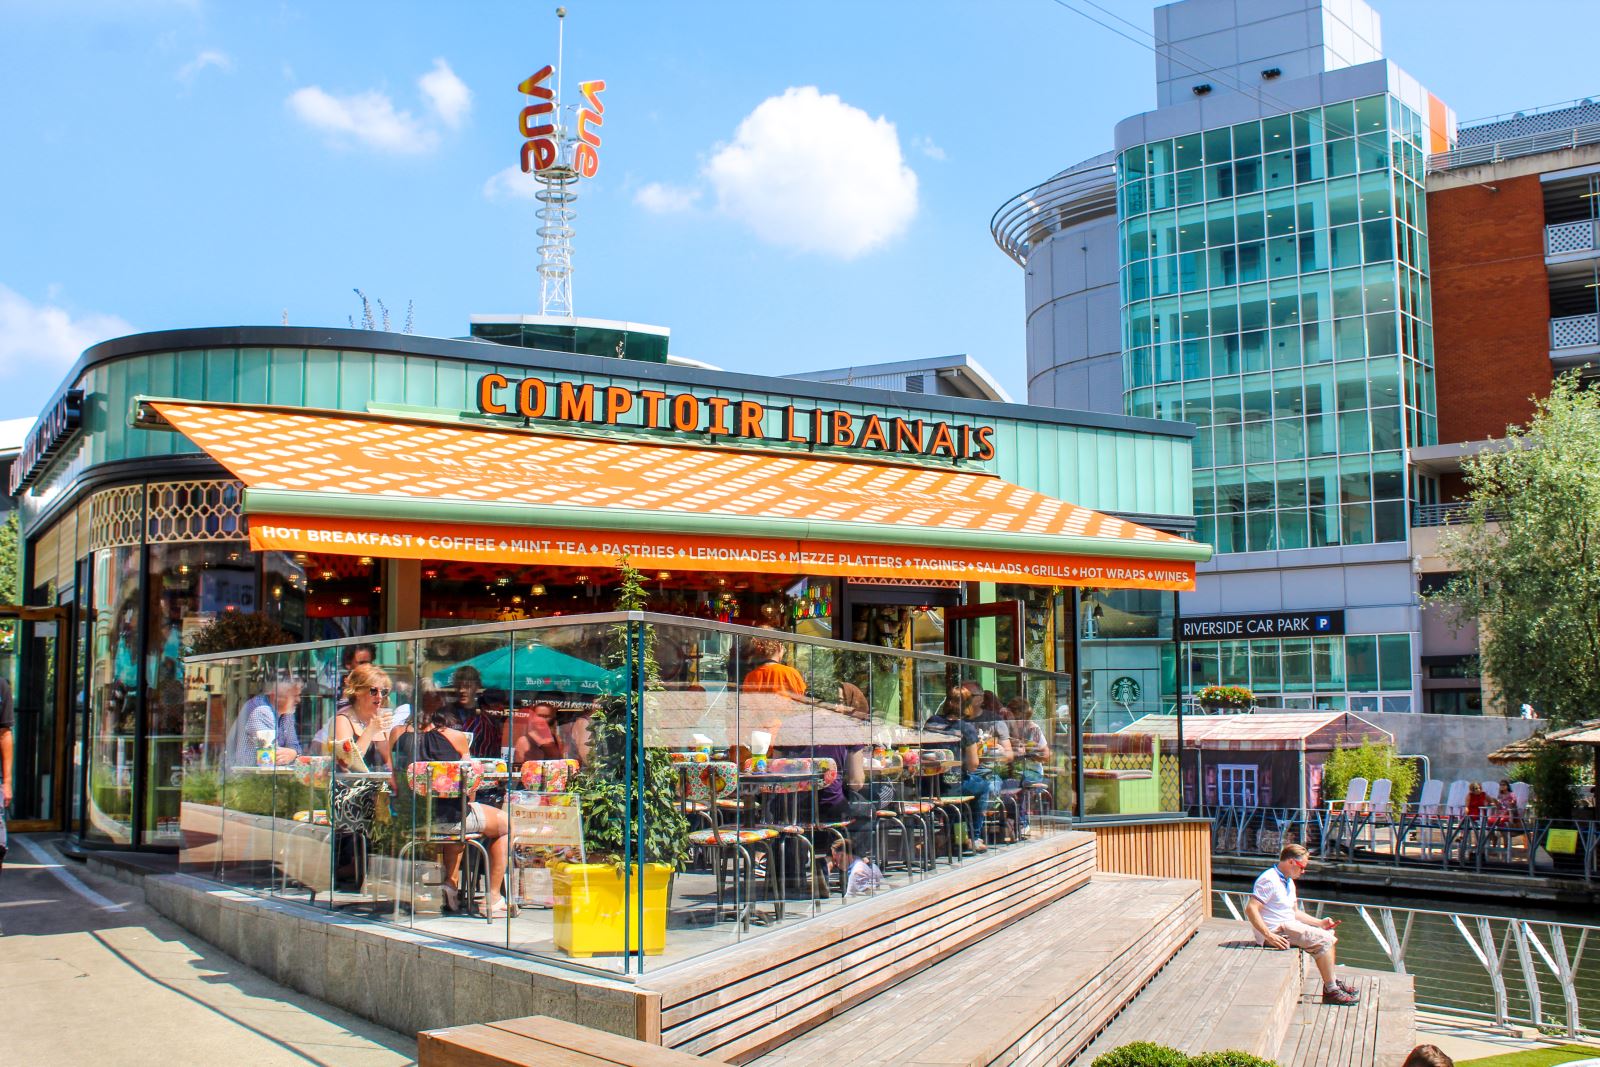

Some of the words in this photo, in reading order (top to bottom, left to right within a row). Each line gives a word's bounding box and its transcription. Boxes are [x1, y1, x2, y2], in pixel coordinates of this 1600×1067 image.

[518, 65, 558, 174] vue
[573, 80, 606, 178] vue
[479, 373, 764, 438] COMPTOIR
[784, 404, 995, 461] LIBANAIS
[361, 450, 604, 475] COMPTOIR
[262, 525, 302, 540] HOT
[306, 528, 414, 548] BREAKFAST
[428, 535, 496, 552] COFFEE
[510, 539, 551, 554] MINT
[555, 540, 588, 556] TEA
[601, 543, 676, 559] PASTRIES
[688, 547, 778, 563] LEMONADES
[788, 551, 835, 566] MEZZE
[838, 553, 903, 569] PLATTERS
[912, 557, 966, 572] TAGINES
[975, 561, 1022, 575] SALADS
[1031, 564, 1071, 577] GRILLS
[1079, 567, 1103, 579] HOT
[1105, 568, 1146, 580] WRAPS
[1153, 570, 1190, 583] WINES
[1183, 620, 1244, 636] RIVERSIDE
[1246, 618, 1275, 634] CAR
[1277, 617, 1311, 632] PARK
[1318, 618, 1328, 629] P
